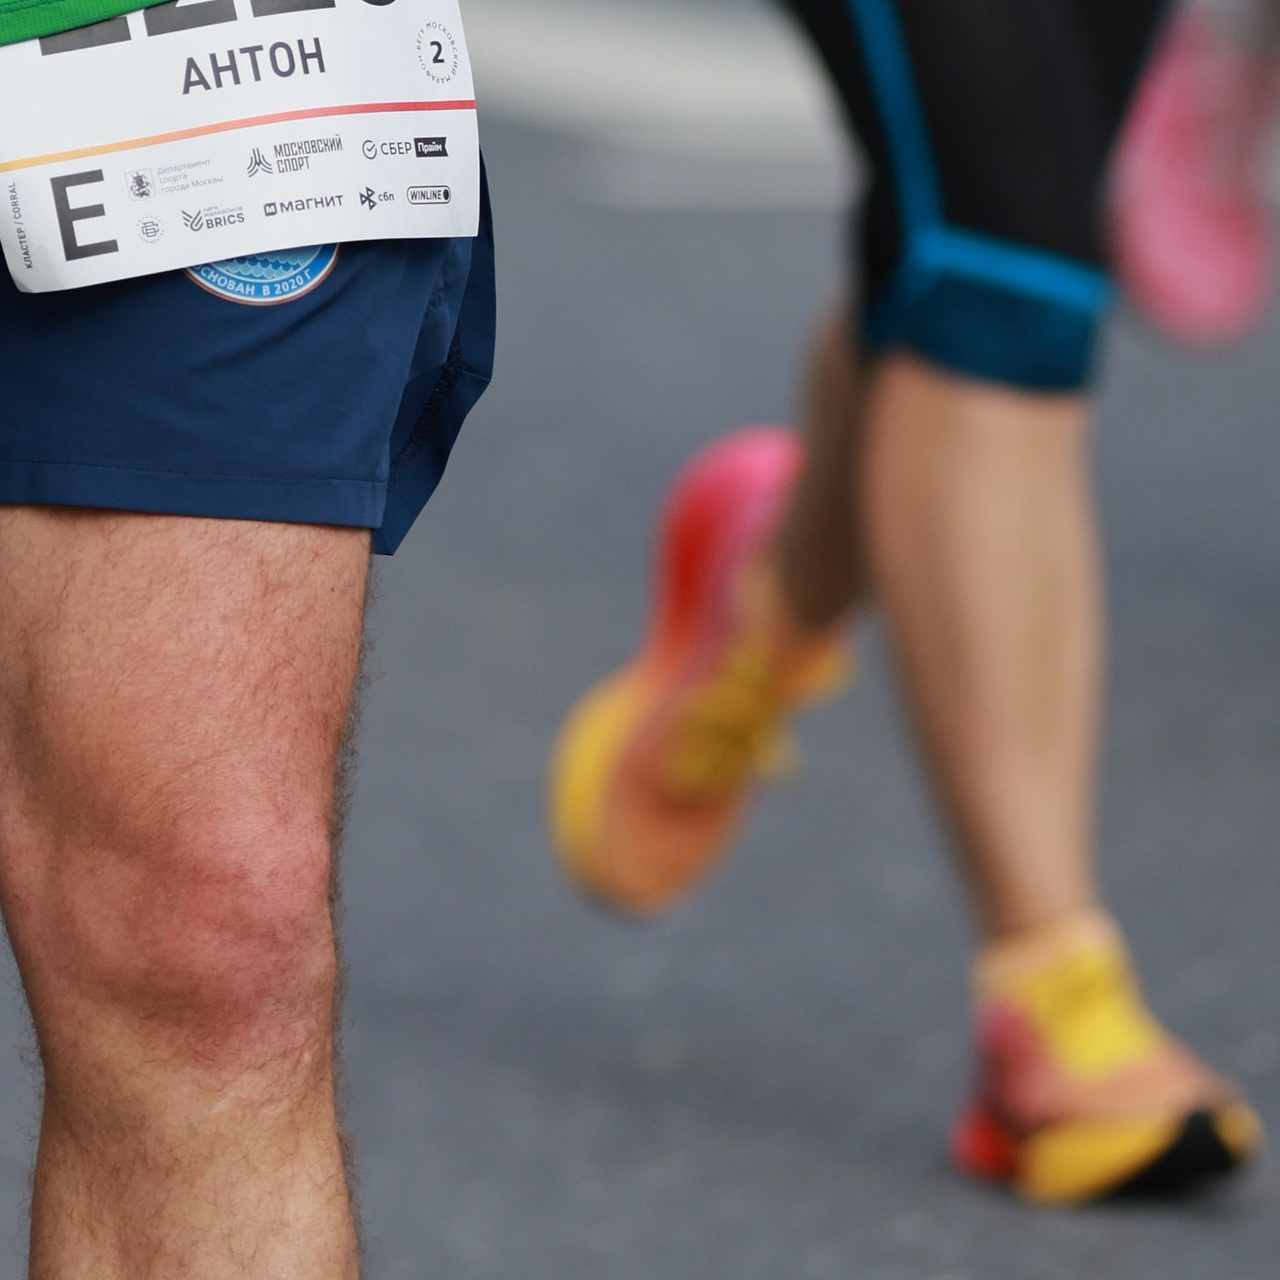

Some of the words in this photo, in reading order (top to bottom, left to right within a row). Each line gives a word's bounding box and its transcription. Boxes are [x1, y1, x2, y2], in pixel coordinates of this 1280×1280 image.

[429, 40, 446, 64] 2
[181, 37, 326, 95] АНТОН
[273, 133, 344, 159] МОСКОВСКИЙ
[380, 141, 413, 156] СБЕР
[417, 140, 443, 155] Прайм
[157, 158, 211, 176] Департамент
[276, 155, 310, 174] СПОРТ
[159, 173, 188, 184] спорта
[161, 182, 190, 195] города
[191, 176, 224, 188] Москвы
[8, 181, 22, 220] CORRAL
[378, 191, 395, 202] сбп
[410, 189, 442, 201] WINLINE
[49, 169, 119, 262] E
[205, 212, 246, 229] BRICS
[16, 227, 33, 270] КЛАСТЕР
[262, 285, 271, 296] В
[274, 277, 305, 296] 2020
